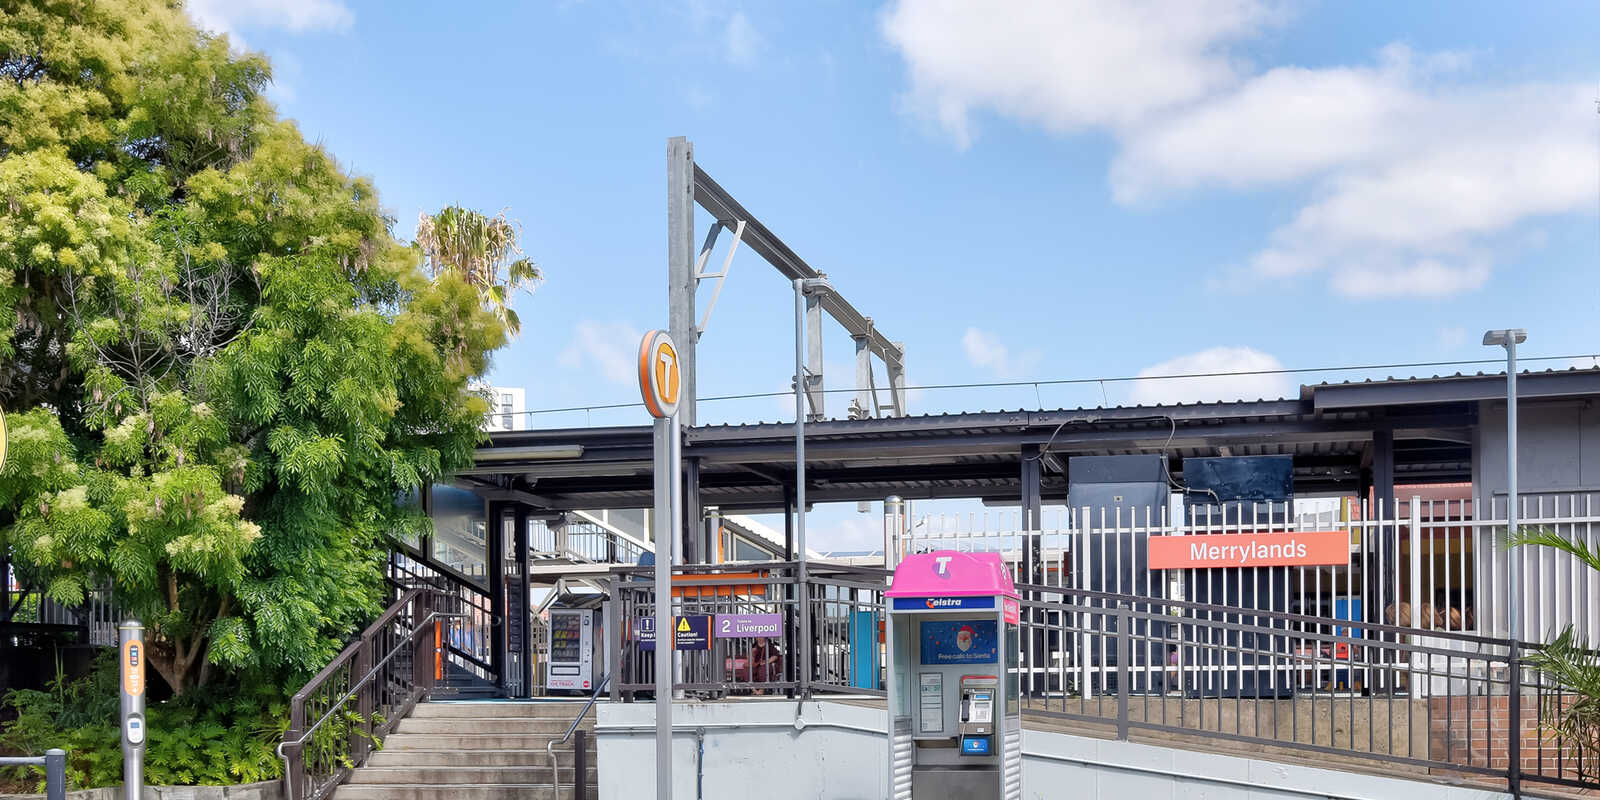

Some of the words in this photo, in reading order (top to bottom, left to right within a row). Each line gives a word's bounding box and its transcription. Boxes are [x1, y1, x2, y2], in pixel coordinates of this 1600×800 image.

[660, 352, 673, 399] T
[1190, 540, 1307, 563] Merrylands
[926, 598, 962, 609] Telstra
[722, 620, 731, 633] 2
[736, 624, 777, 634] Liverpool
